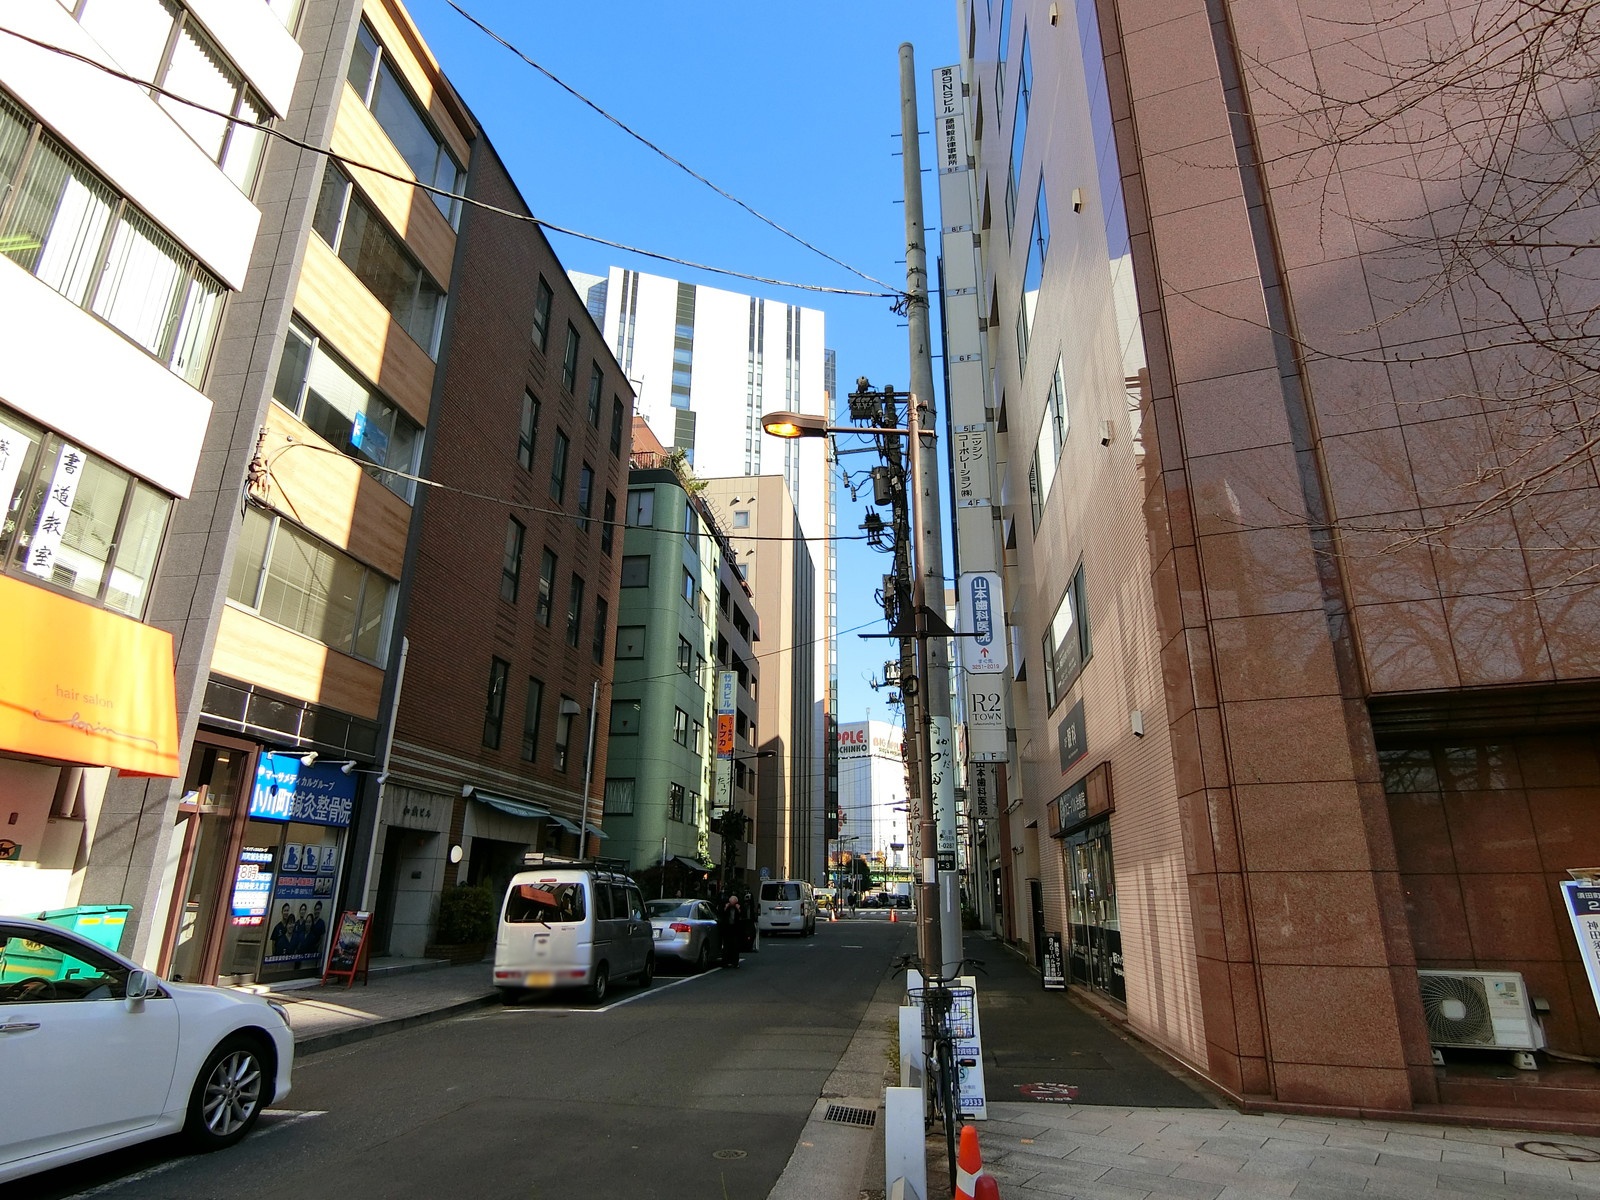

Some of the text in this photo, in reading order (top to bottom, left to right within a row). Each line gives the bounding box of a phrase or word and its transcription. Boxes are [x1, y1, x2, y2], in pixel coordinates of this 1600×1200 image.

[941, 68, 955, 114] 第9NSビル
[972, 433, 983, 461] ニッシン
[33, 453, 81, 568] 書道教室
[973, 578, 991, 643] 山本歯科医院
[56, 684, 113, 709] hair salon
[723, 673, 732, 708] 竹内ビル
[972, 693, 1001, 712] R2
[972, 713, 1002, 721] TOWN
[250, 784, 352, 824] 小川町鍼灸整骨院
